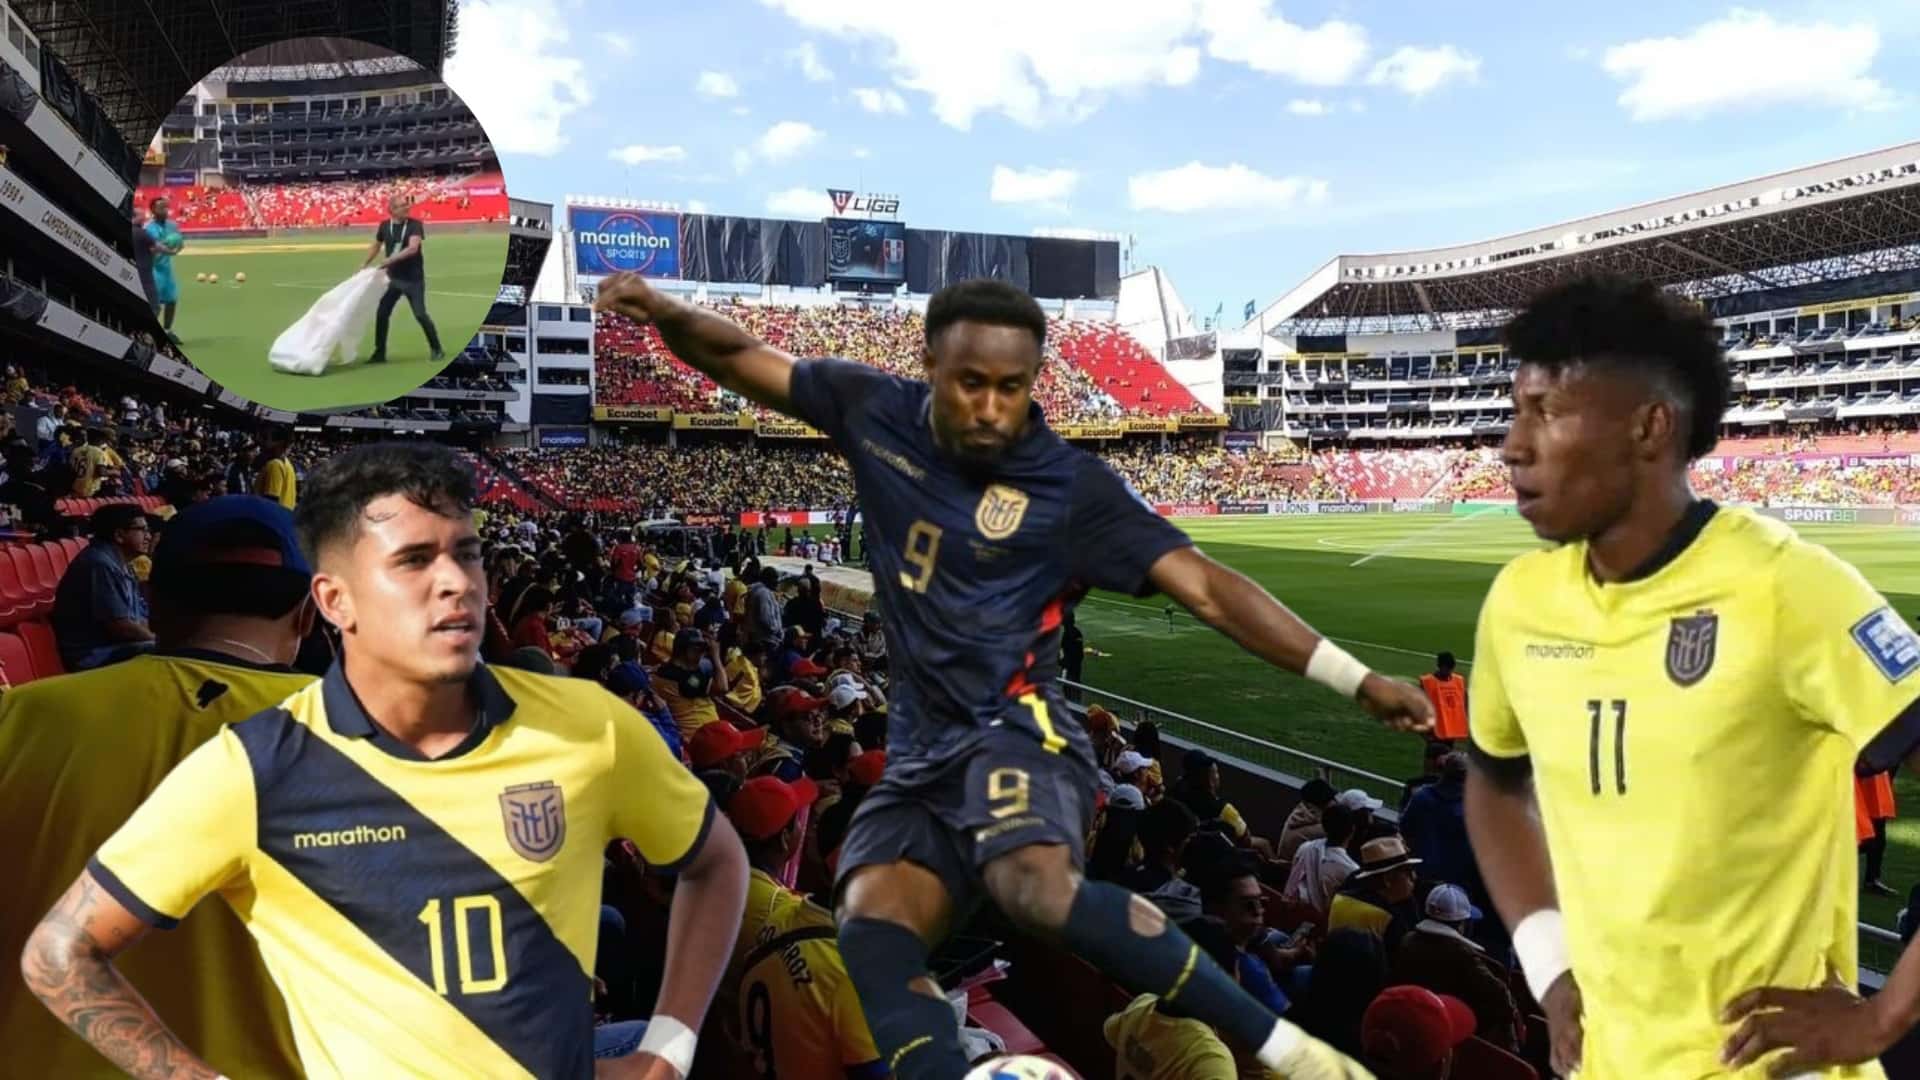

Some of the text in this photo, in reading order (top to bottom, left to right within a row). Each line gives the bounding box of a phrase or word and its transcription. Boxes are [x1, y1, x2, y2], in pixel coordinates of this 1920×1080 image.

[580, 229, 670, 249] marathon
[606, 248, 646, 260] SPORTS
[607, 409, 658, 419] Ecuabet
[1180, 415, 1218, 425] Ecuabet
[690, 417, 739, 427] Ecuabet
[1129, 421, 1167, 431] Ecuabet
[759, 425, 807, 436] Ecuabet
[1081, 428, 1120, 437] Ecuabet
[1321, 503, 1365, 513] marathon
[900, 519, 944, 594] 9
[1525, 643, 1594, 659] marathon
[1587, 699, 1627, 796] 11
[988, 767, 1030, 819] 9
[294, 824, 406, 849] marathon
[418, 894, 508, 996] 10
